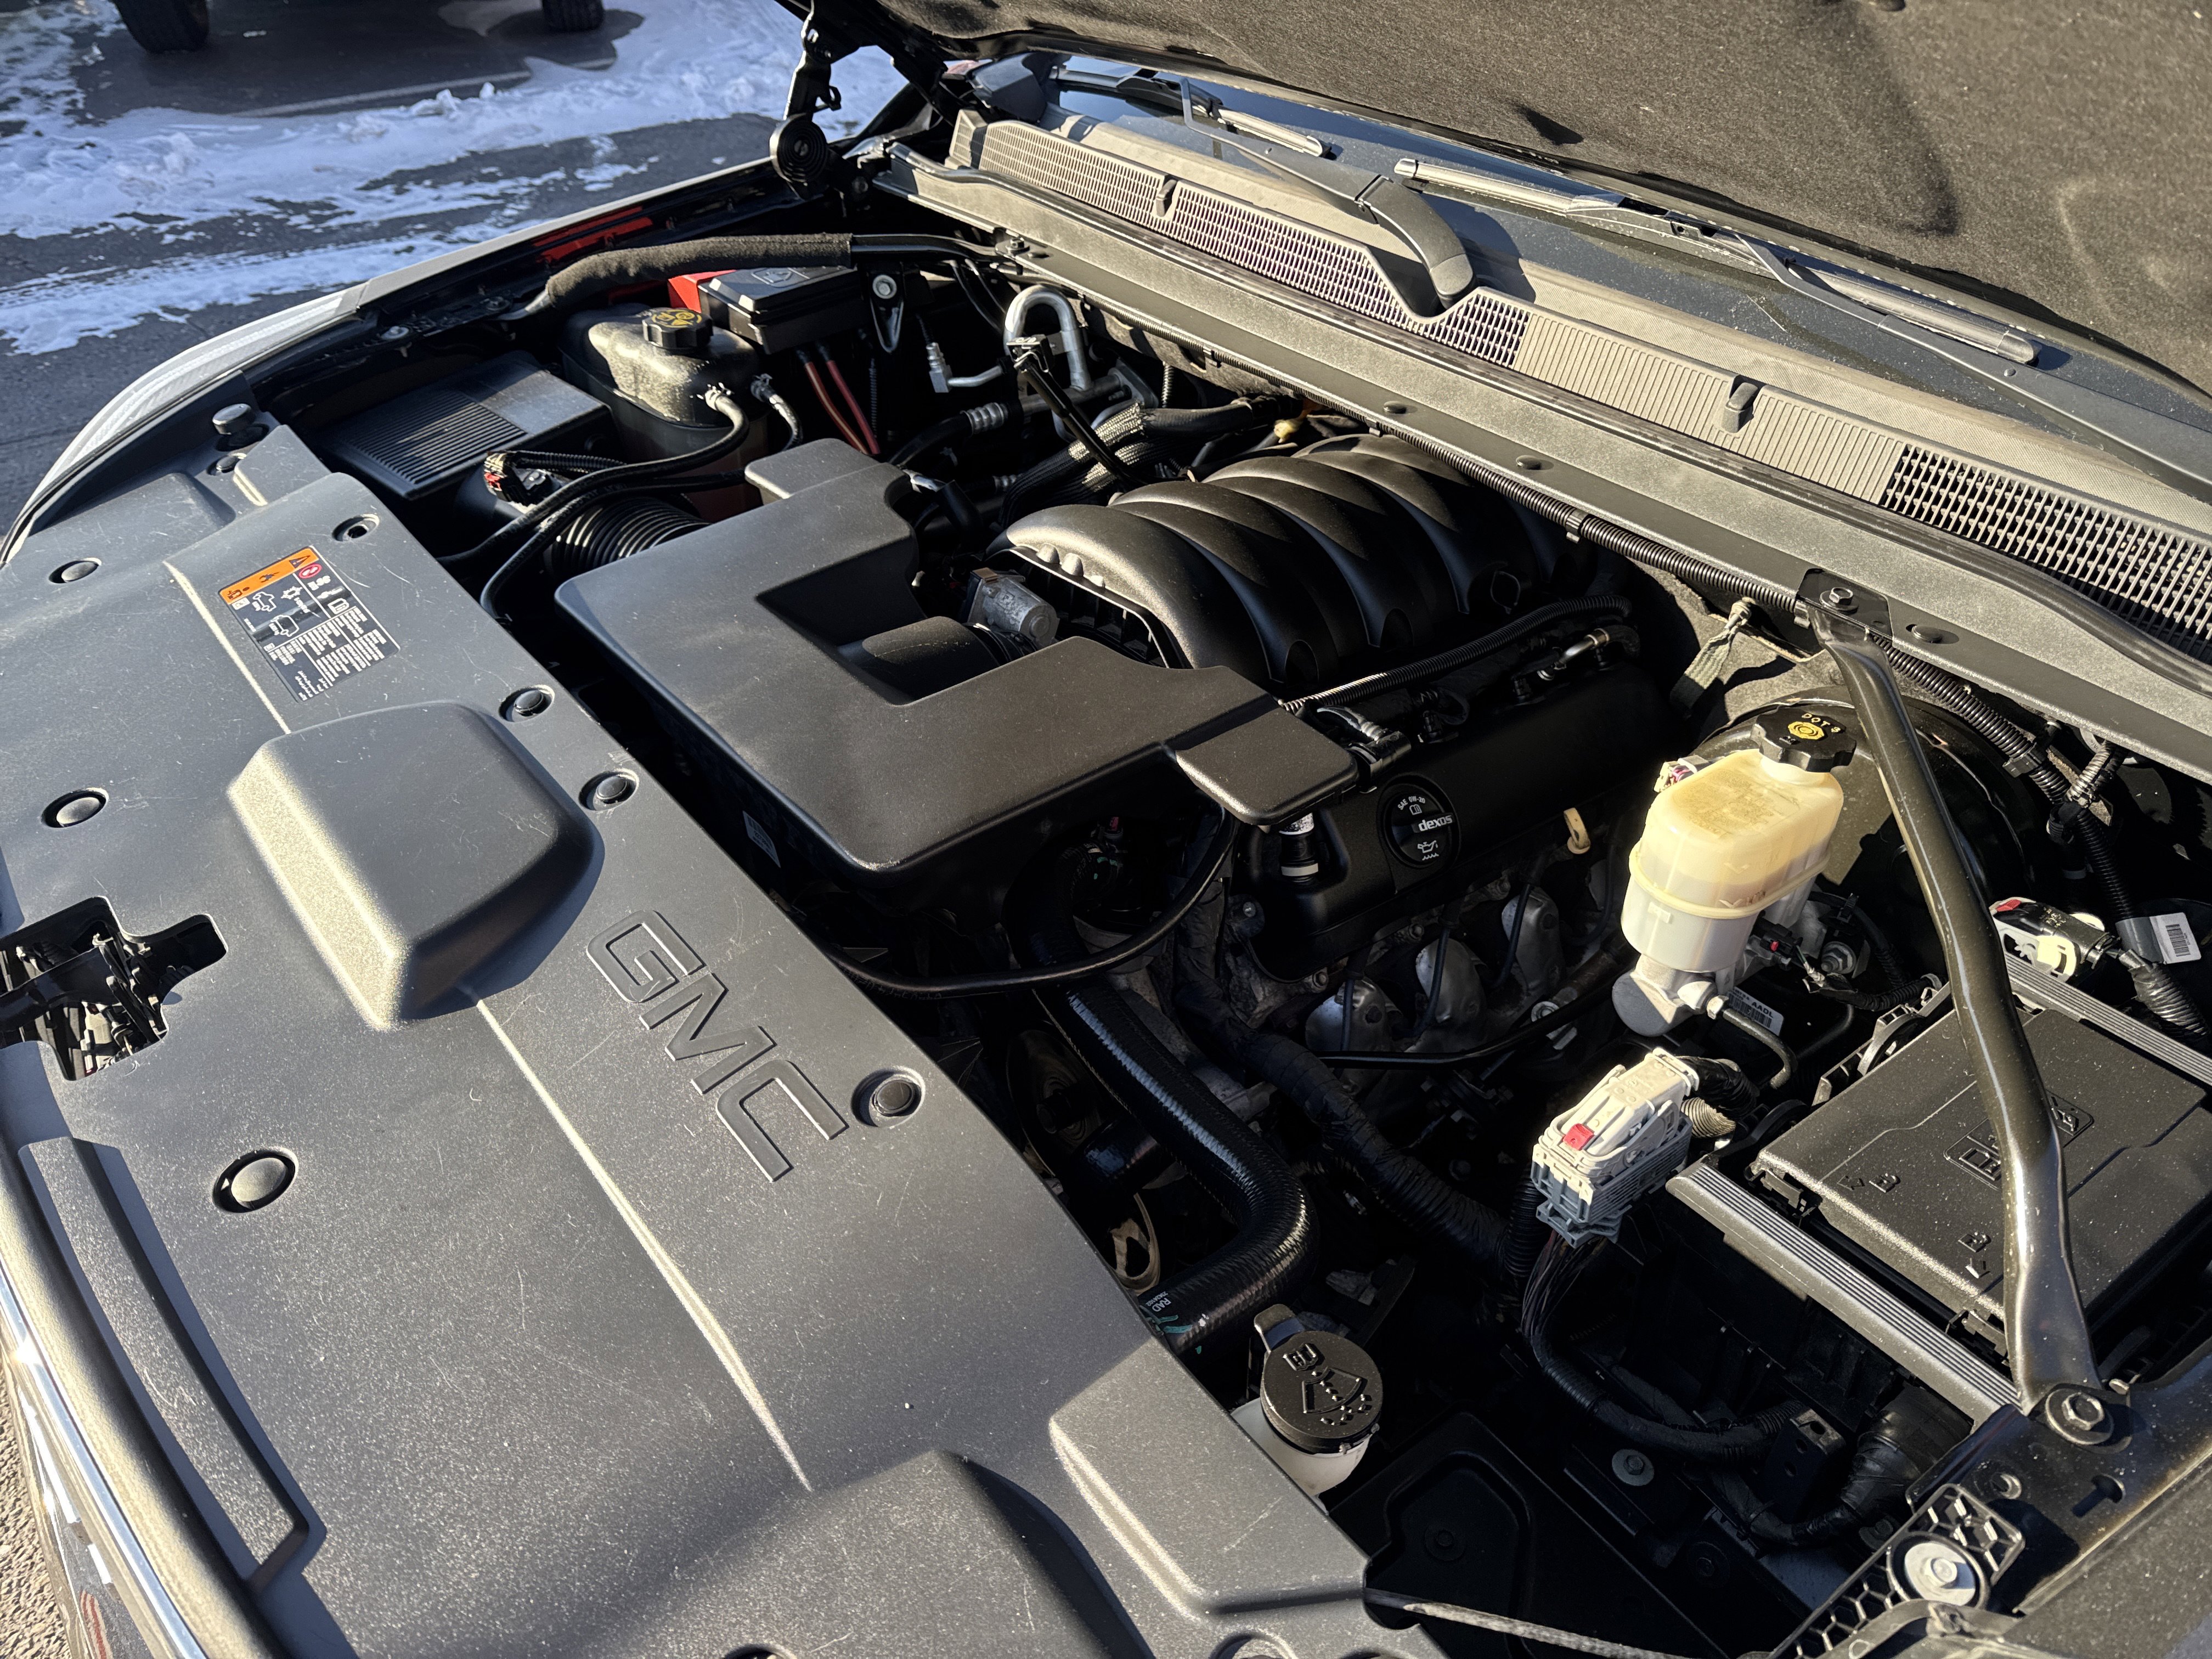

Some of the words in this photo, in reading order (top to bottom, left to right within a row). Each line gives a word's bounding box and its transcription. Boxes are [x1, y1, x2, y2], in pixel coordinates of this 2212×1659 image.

[1801, 713, 1830, 726] DOT
[1397, 799, 1408, 810] SAE
[1408, 795, 1426, 804] 0W-20
[1418, 815, 1453, 832] dexos
[1751, 1002, 1774, 1018] AADL
[586, 909, 850, 1183] GMC
[1152, 1297, 1171, 1312] RAD
